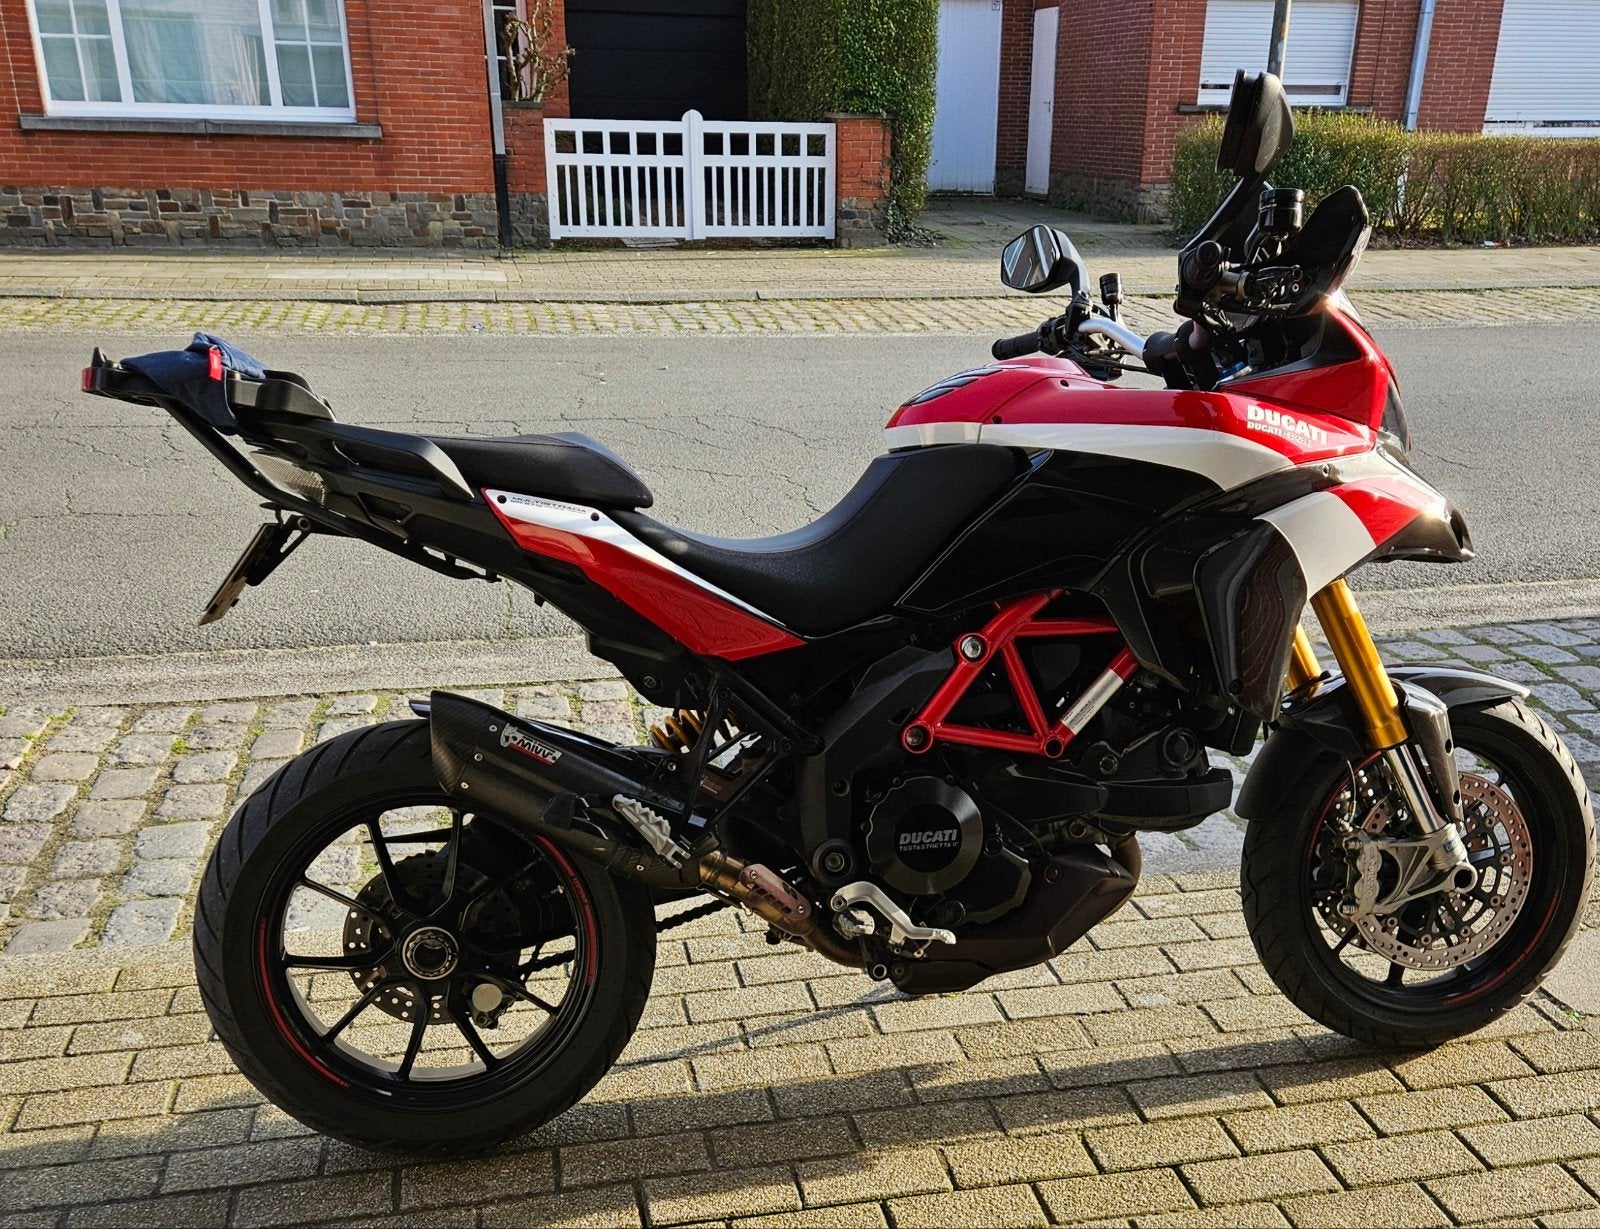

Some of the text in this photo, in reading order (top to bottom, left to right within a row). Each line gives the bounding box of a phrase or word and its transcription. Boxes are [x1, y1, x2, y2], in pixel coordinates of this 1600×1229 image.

[1246, 421, 1281, 437] DUCATI
[1247, 404, 1327, 445] DUCATI
[899, 829, 958, 844] DUCATI
[899, 842, 951, 851] TESTASTRETTA
